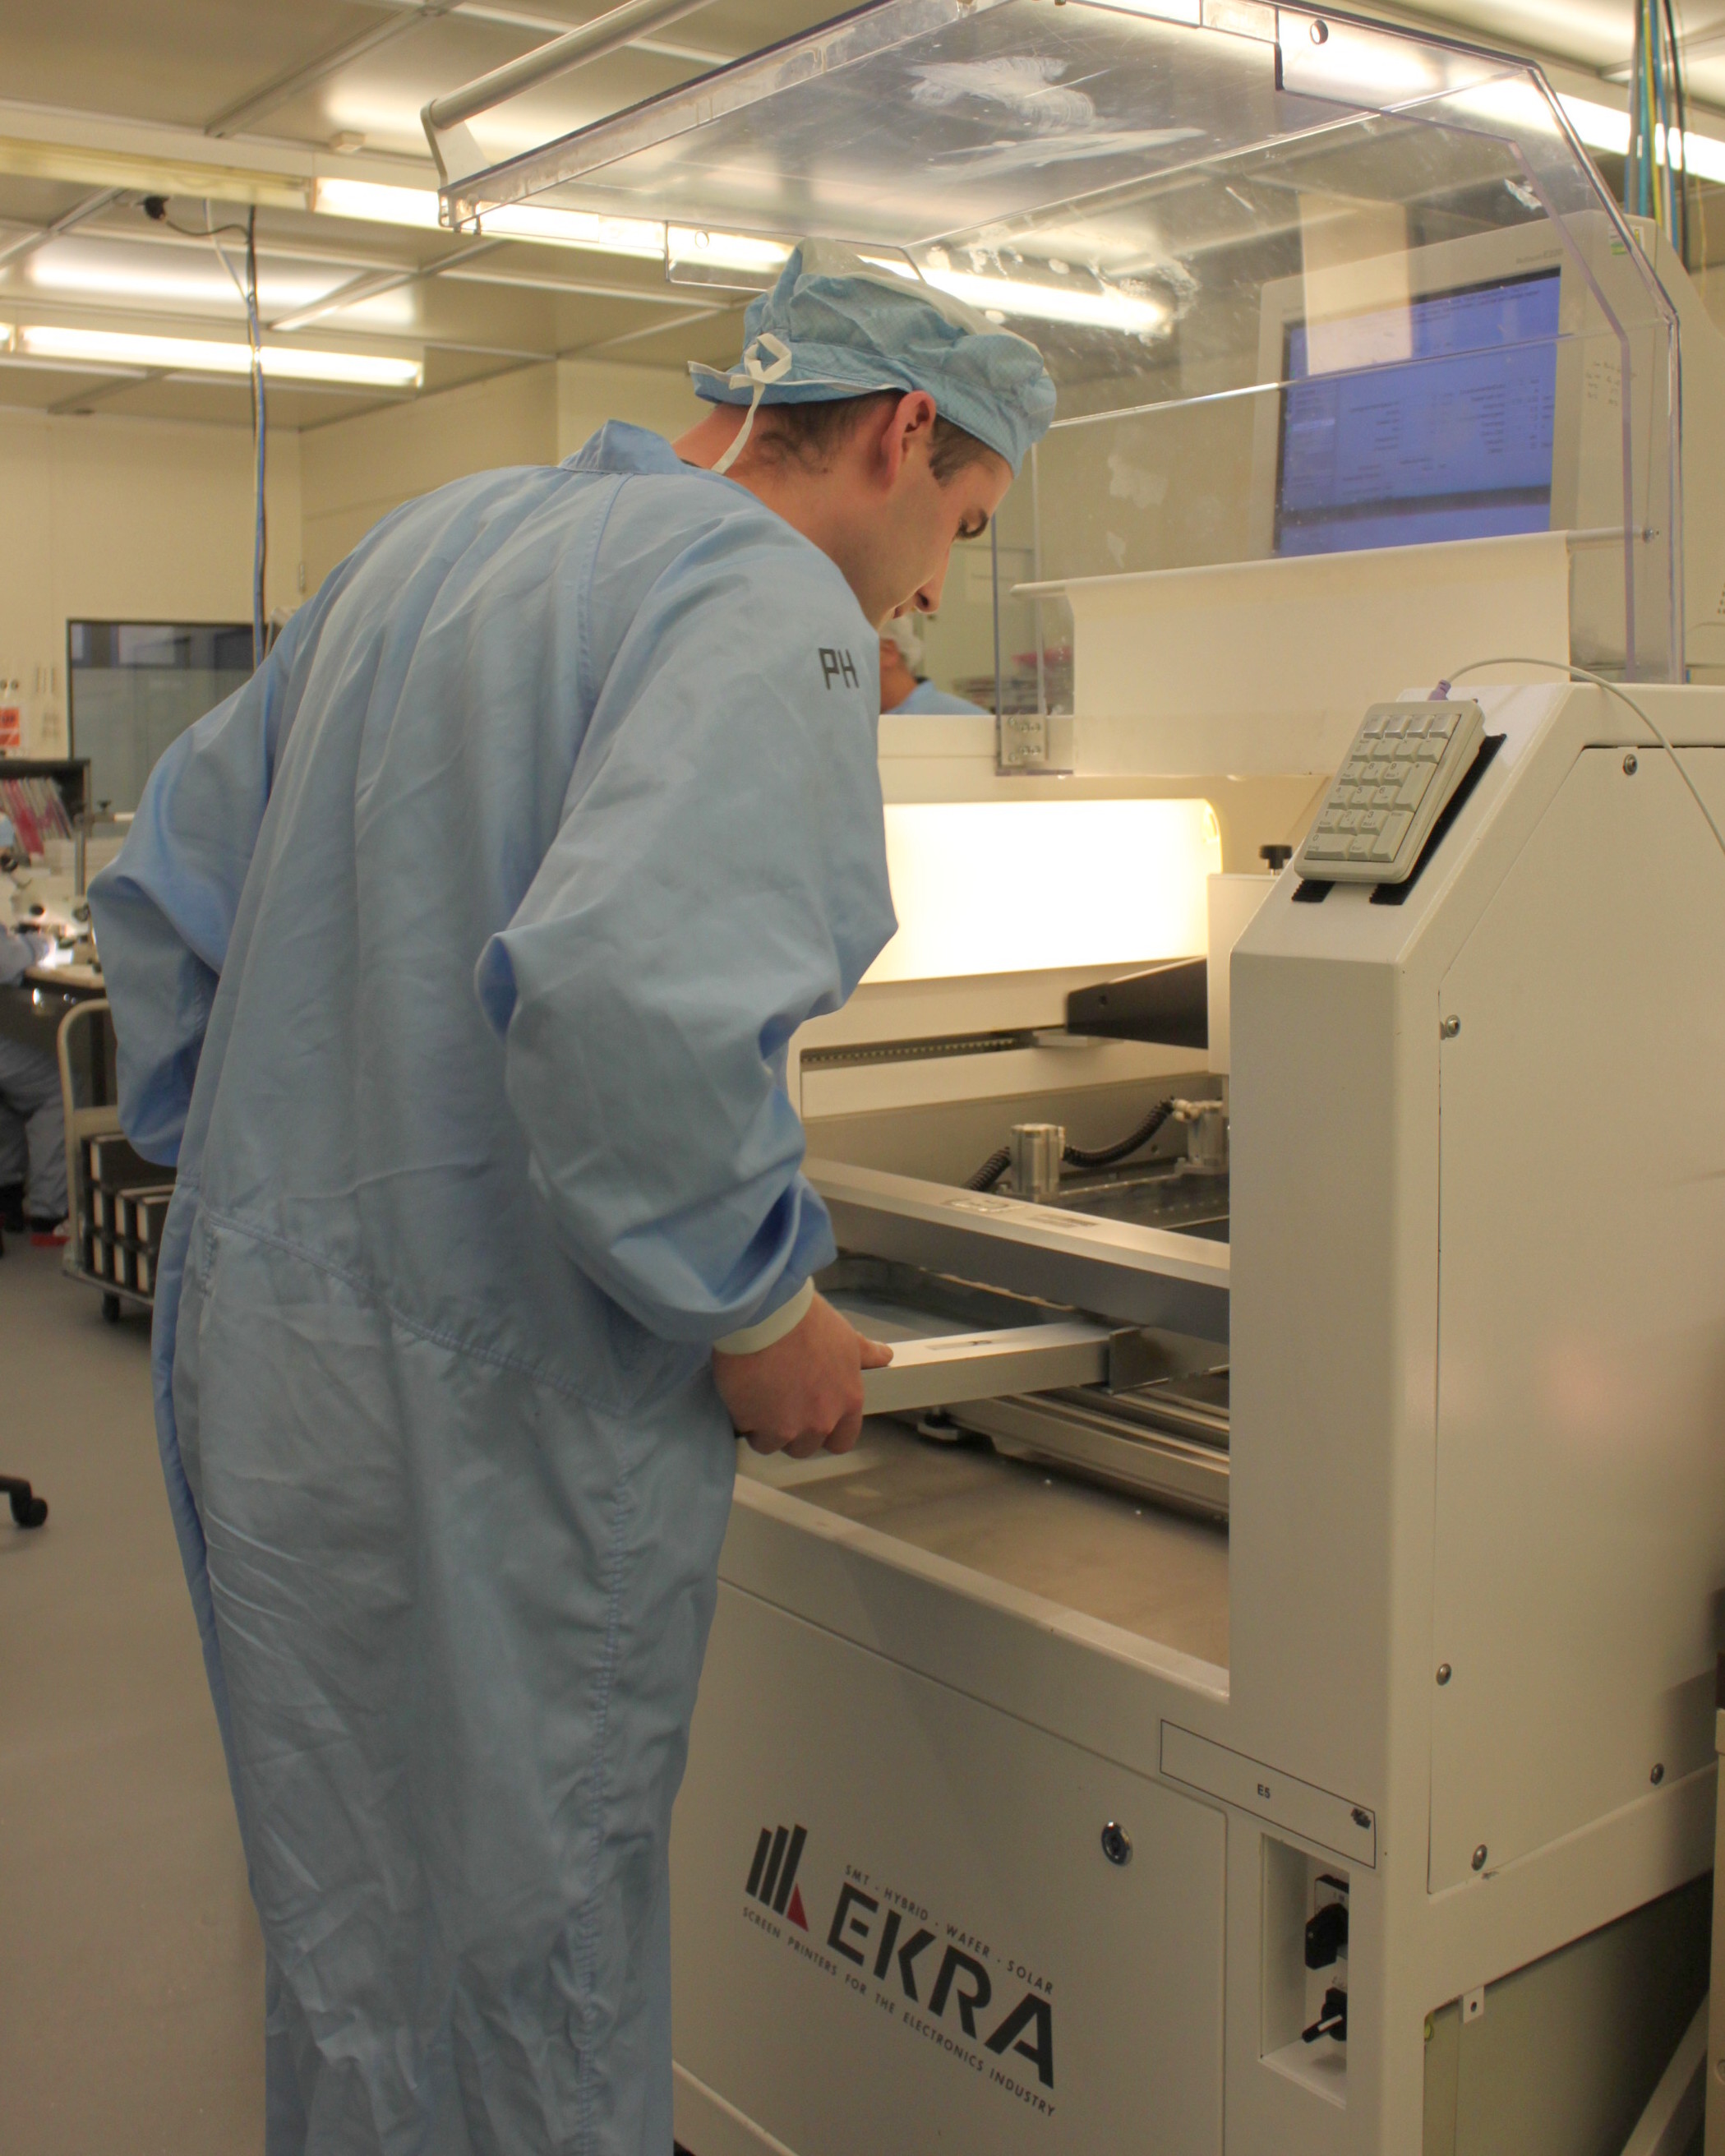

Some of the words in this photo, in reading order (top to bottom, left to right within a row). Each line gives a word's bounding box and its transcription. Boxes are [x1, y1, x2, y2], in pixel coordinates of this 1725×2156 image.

[819, 647, 859, 690] PH
[1257, 1783, 1271, 1799] E5
[827, 1881, 1054, 2089] EKRA
[845, 1864, 870, 1886] SMT
[883, 1887, 929, 1922] HYBRID
[947, 1923, 991, 1959] WAFER
[1007, 1960, 1054, 1996] SOLAR
[742, 1906, 781, 1939] SCREEN
[786, 1937, 837, 1977] PRINTERS
[844, 1976, 867, 1996] FOR
[874, 1992, 897, 2015] THE
[902, 2011, 985, 2073] ELECTRONICS
[989, 2067, 1056, 2118] INDUSTRY
